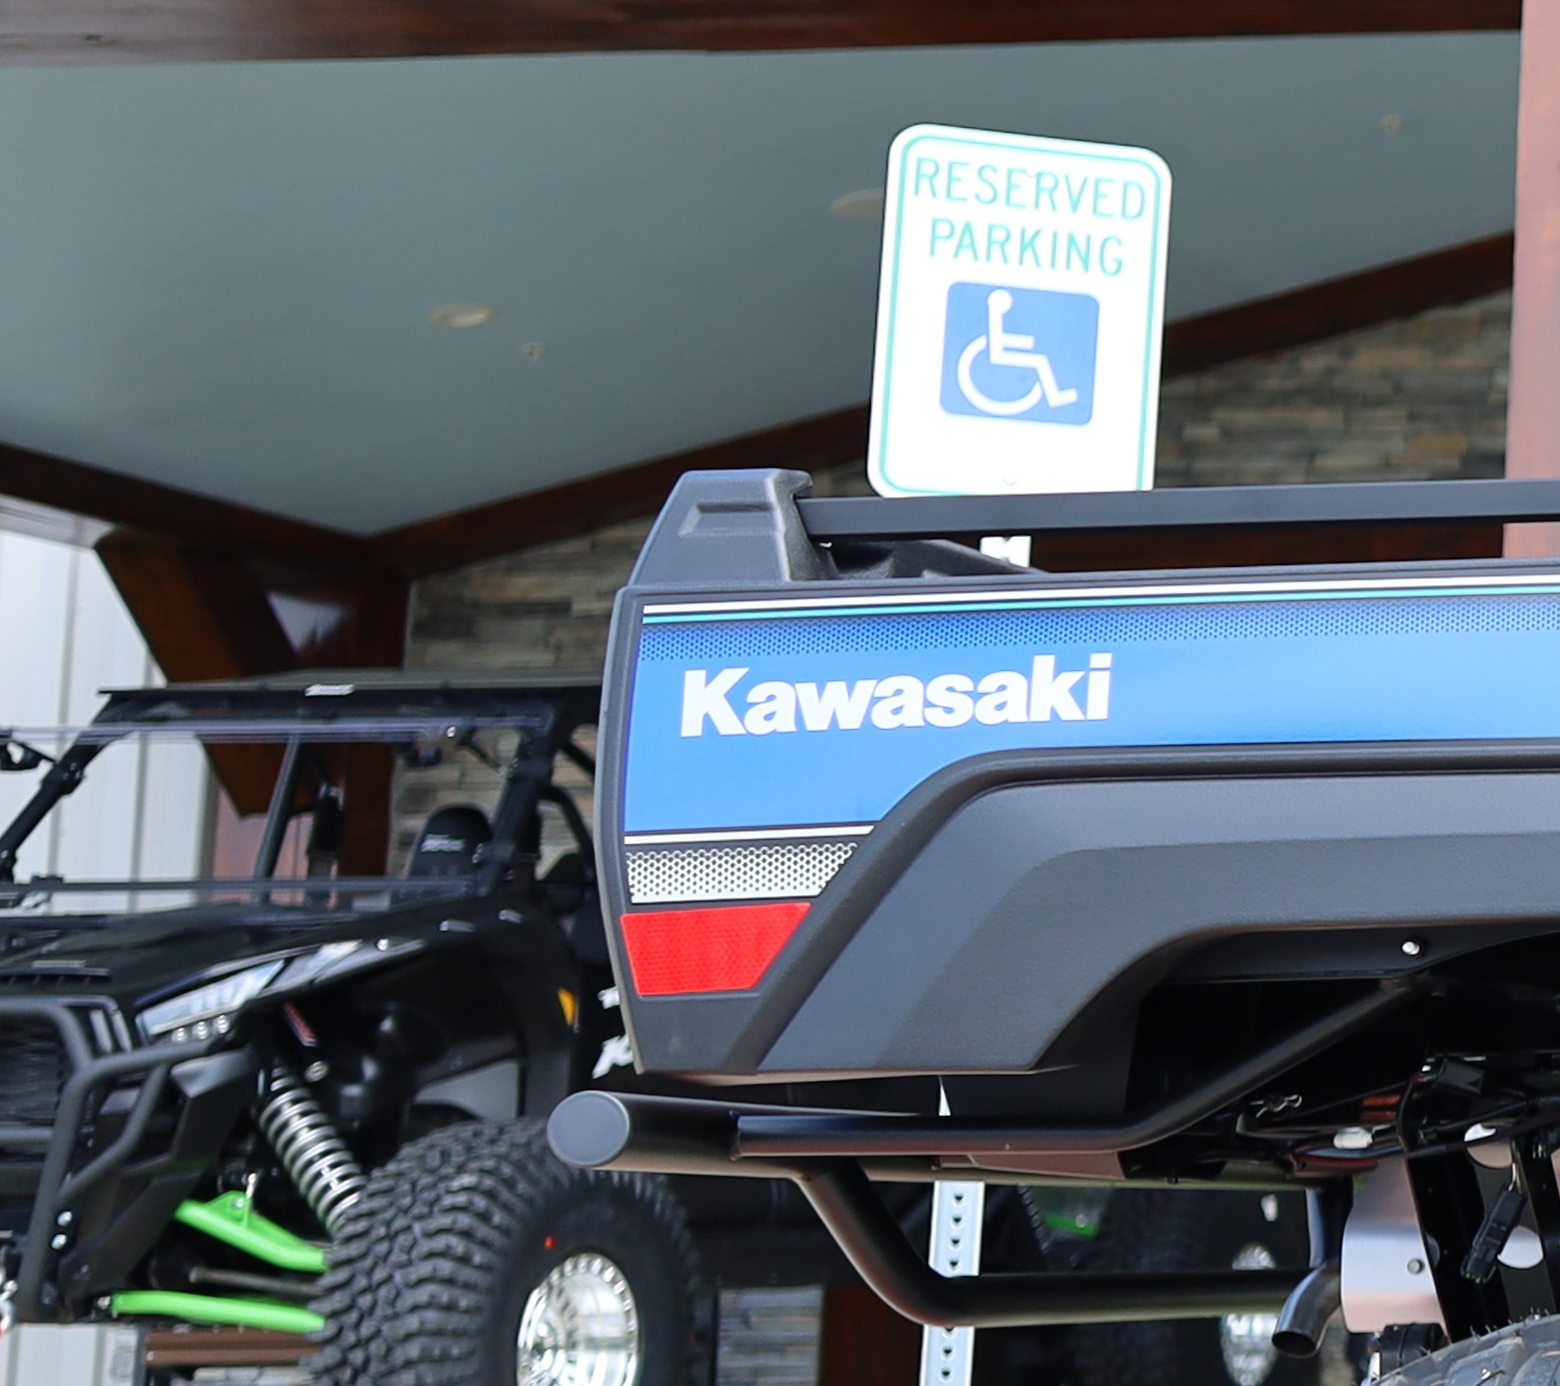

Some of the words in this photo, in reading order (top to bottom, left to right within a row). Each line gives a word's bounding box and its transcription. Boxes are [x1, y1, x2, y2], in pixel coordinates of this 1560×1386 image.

[913, 157, 1147, 221] RESERVED
[929, 218, 1125, 277] PARKING
[680, 653, 1113, 738] Kawasaki
